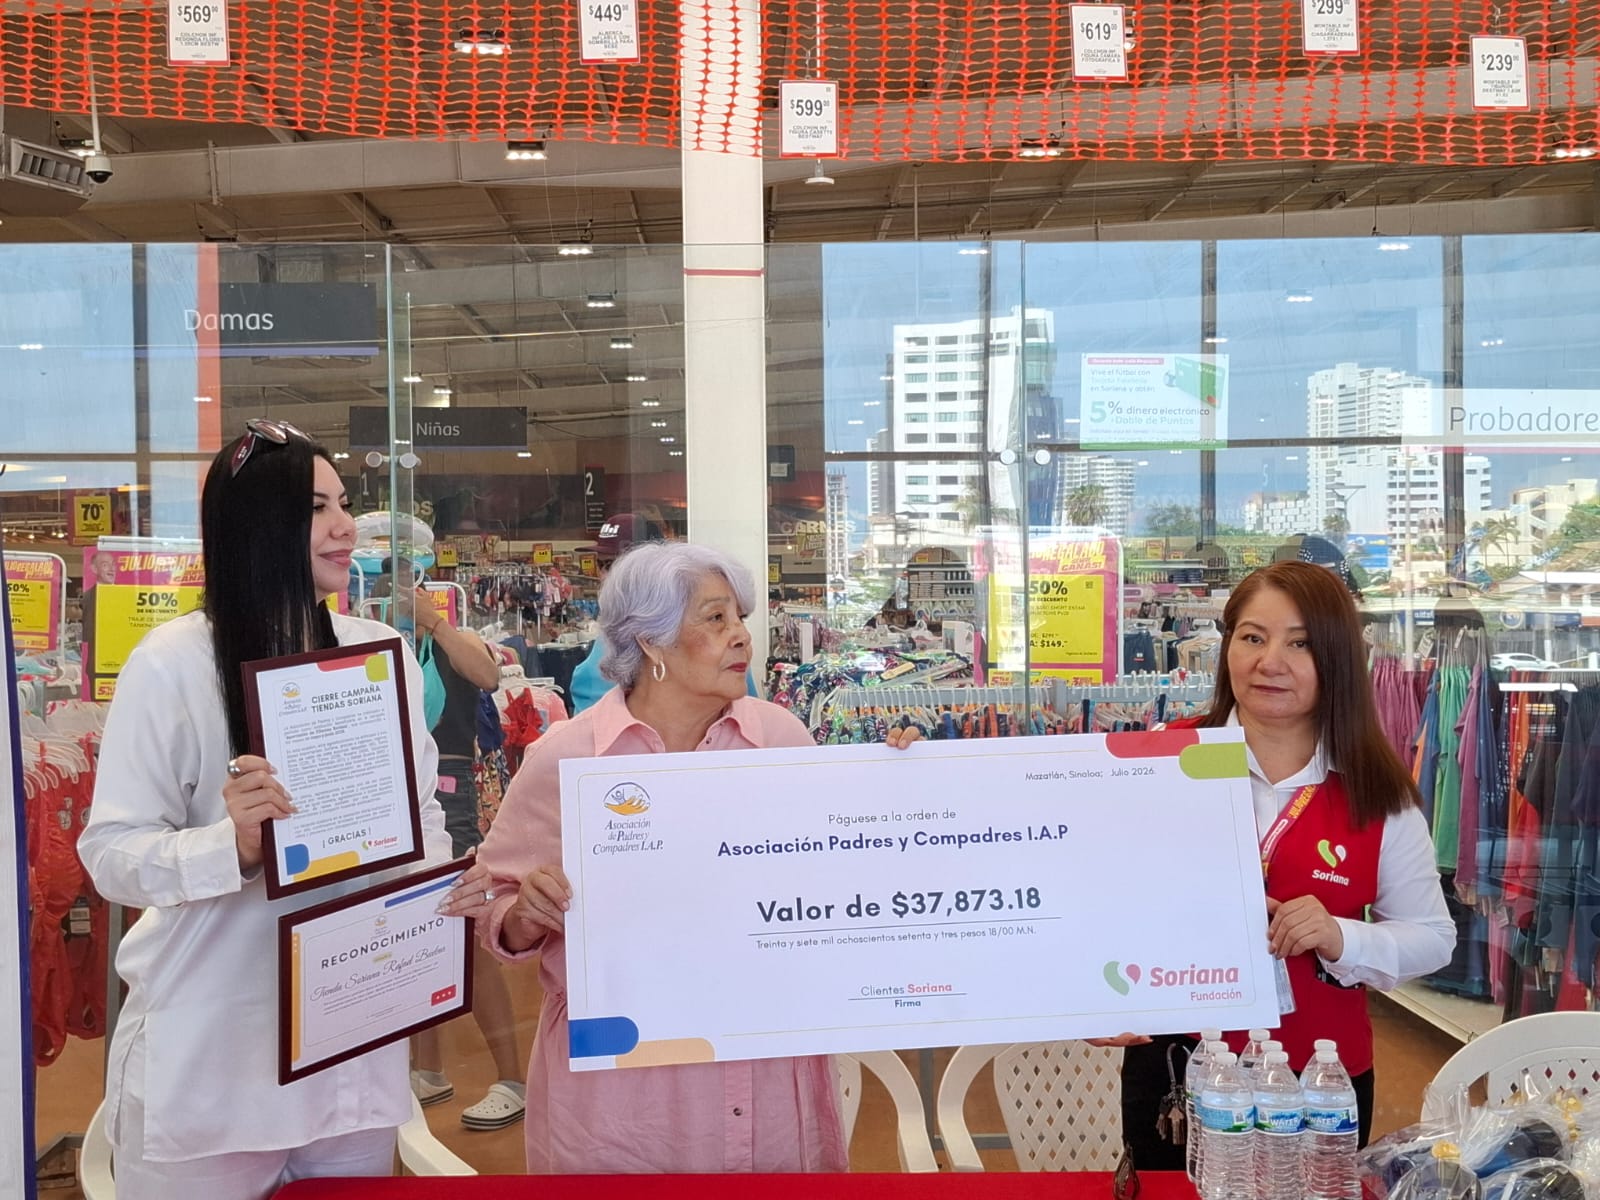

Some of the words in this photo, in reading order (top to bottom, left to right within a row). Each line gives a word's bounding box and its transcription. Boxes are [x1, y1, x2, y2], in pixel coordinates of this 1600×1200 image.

[184, 309, 275, 331] Damas
[1126, 406, 1158, 415] dinero
[1450, 406, 1600, 431] Probadore
[416, 422, 460, 436] Niñas
[586, 472, 594, 495] 2
[1029, 580, 1068, 595] 50%
[136, 592, 178, 607] 50%
[311, 693, 339, 704] CIERRE
[341, 684, 381, 698] CAMPAÑA
[311, 701, 345, 713] TIENDAS
[347, 694, 382, 708] SORIANA
[1110, 767, 1129, 777] Julio
[605, 818, 651, 830] Asociación
[828, 813, 877, 827] Páguese
[892, 810, 902, 821] la
[906, 809, 938, 821] orden
[942, 808, 957, 819] de
[327, 829, 367, 845] GRACIAS
[717, 836, 823, 856] Asociación
[828, 833, 894, 851] Padres
[898, 837, 909, 852] y
[914, 826, 1023, 849] Compadres
[1027, 824, 1068, 841] I.A.P
[1312, 869, 1350, 886] Soriana
[756, 896, 835, 923] Valor
[845, 894, 881, 918] de
[891, 887, 1042, 919] $37,873.18
[321, 917, 445, 969] RECONOCIMIENTO
[756, 940, 787, 949] Treinta
[789, 941, 794, 950] y
[797, 939, 818, 947] siete
[821, 937, 834, 945] mil
[898, 932, 931, 942] setenta
[934, 933, 939, 942] y
[941, 930, 958, 938] tres
[960, 929, 986, 940] pesos
[988, 926, 1014, 938] 18/00
[1016, 925, 1037, 935] M.N.
[1150, 963, 1239, 987] Soriana
[860, 985, 905, 996] Clientes
[907, 983, 952, 993] Soriana
[1190, 988, 1242, 1001] Fundación
[894, 999, 921, 1008] Firma
